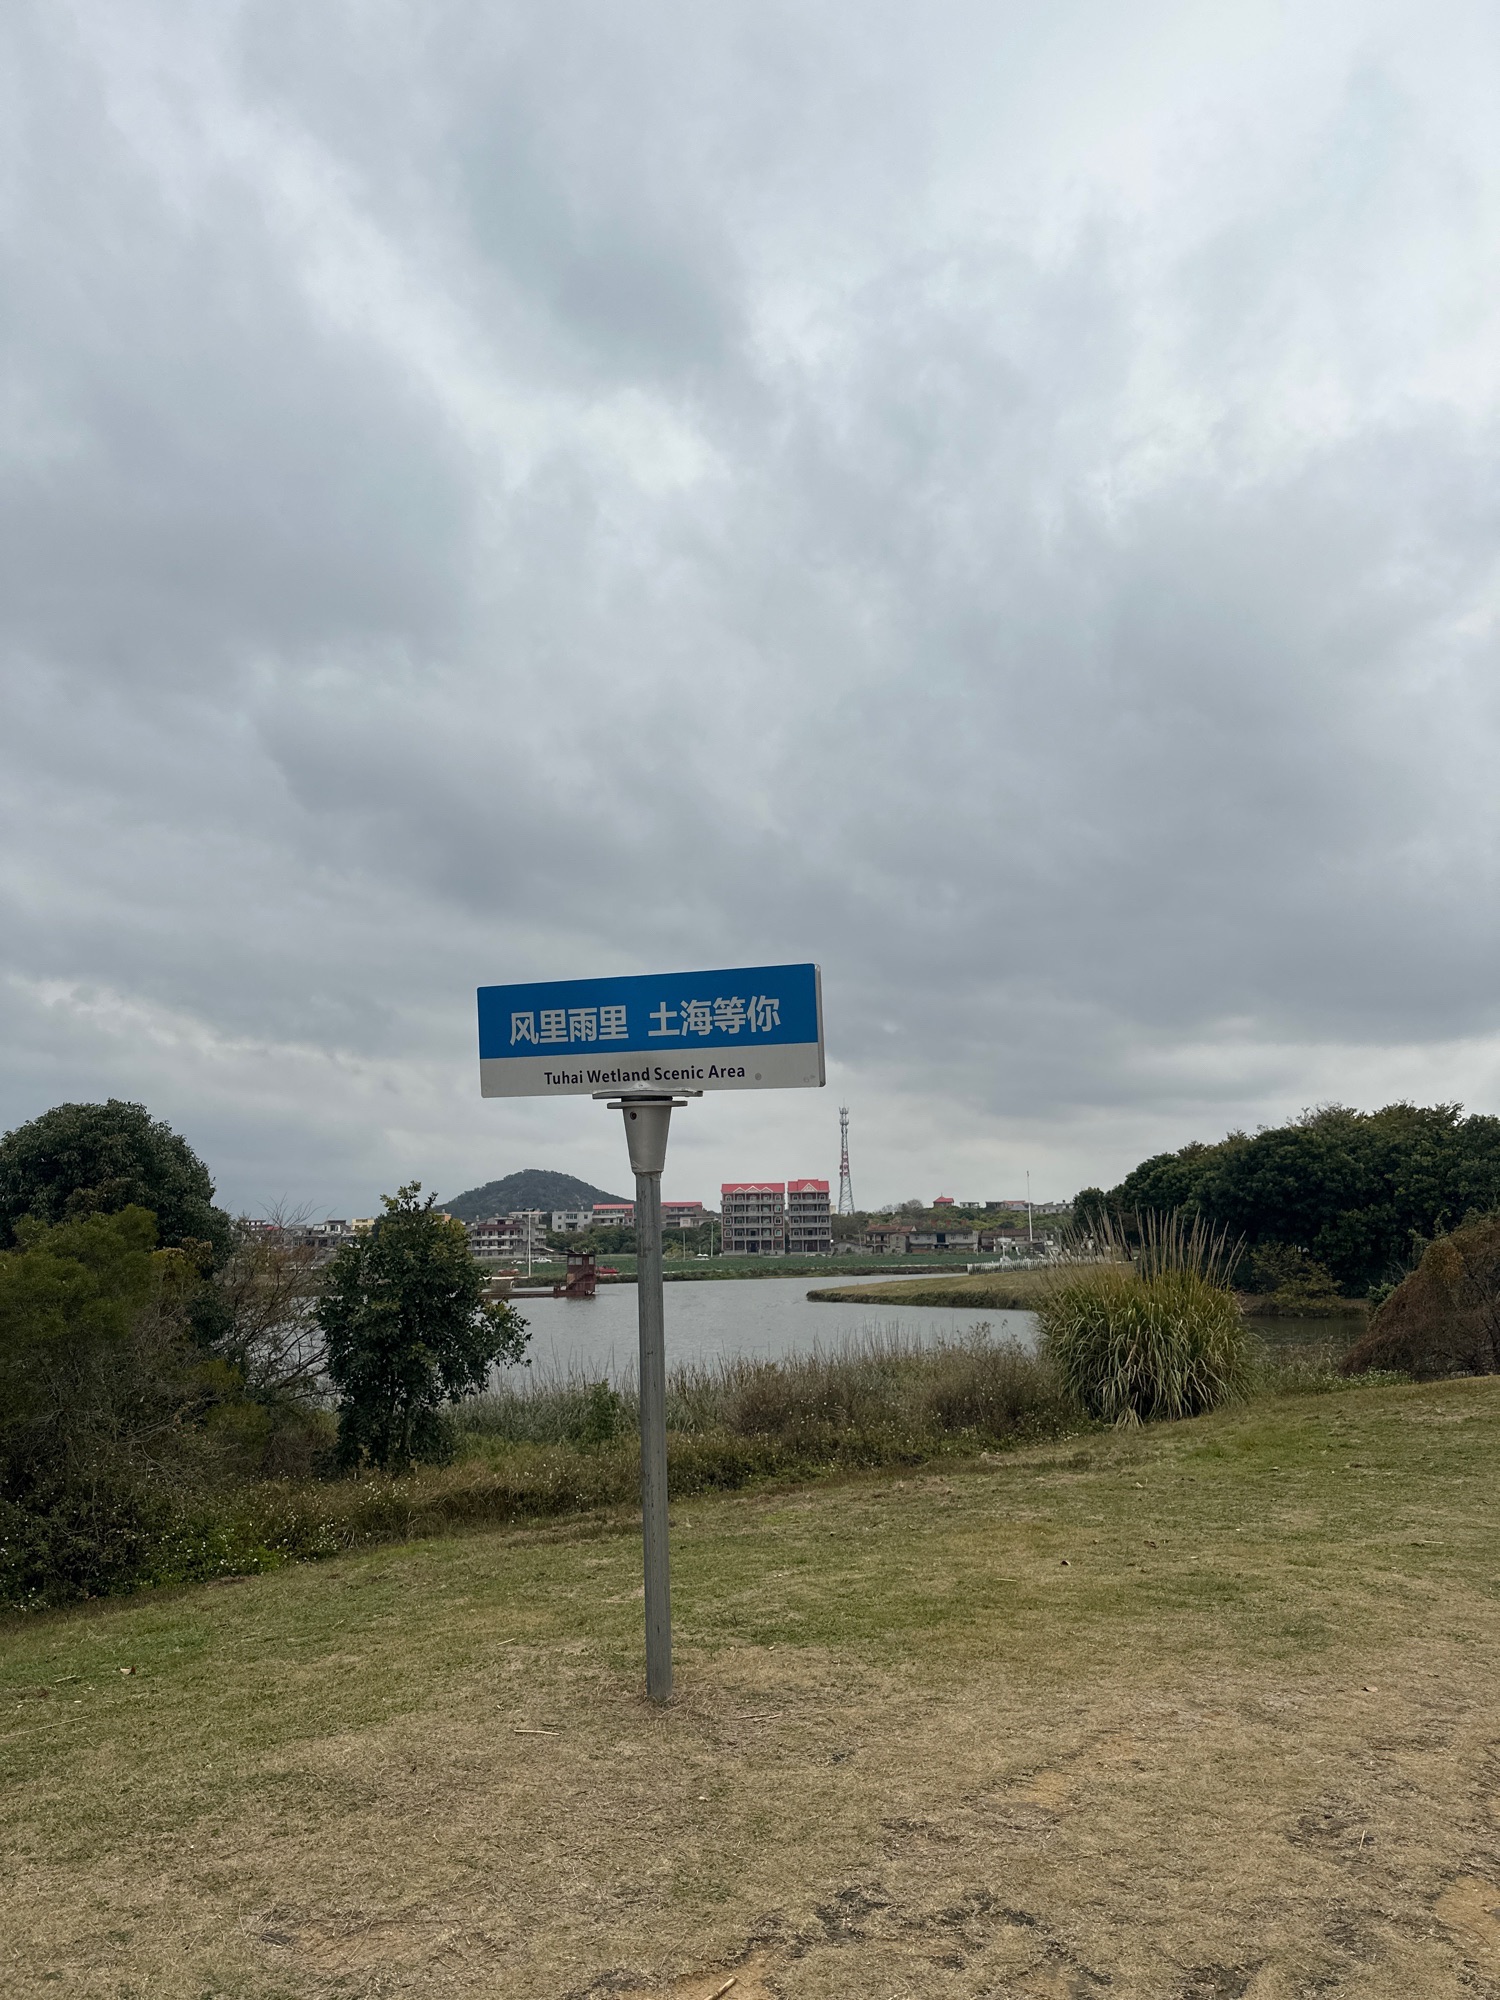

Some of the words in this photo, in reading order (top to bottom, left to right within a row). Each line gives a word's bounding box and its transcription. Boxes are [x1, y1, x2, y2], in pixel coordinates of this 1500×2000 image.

[509, 1005, 629, 1046] 风里雨里
[647, 994, 781, 1038] 土海等你
[544, 1070, 583, 1085] Tuhai
[587, 1067, 650, 1083] Wetland
[654, 1065, 704, 1081] Scenic
[708, 1064, 745, 1078] Area
